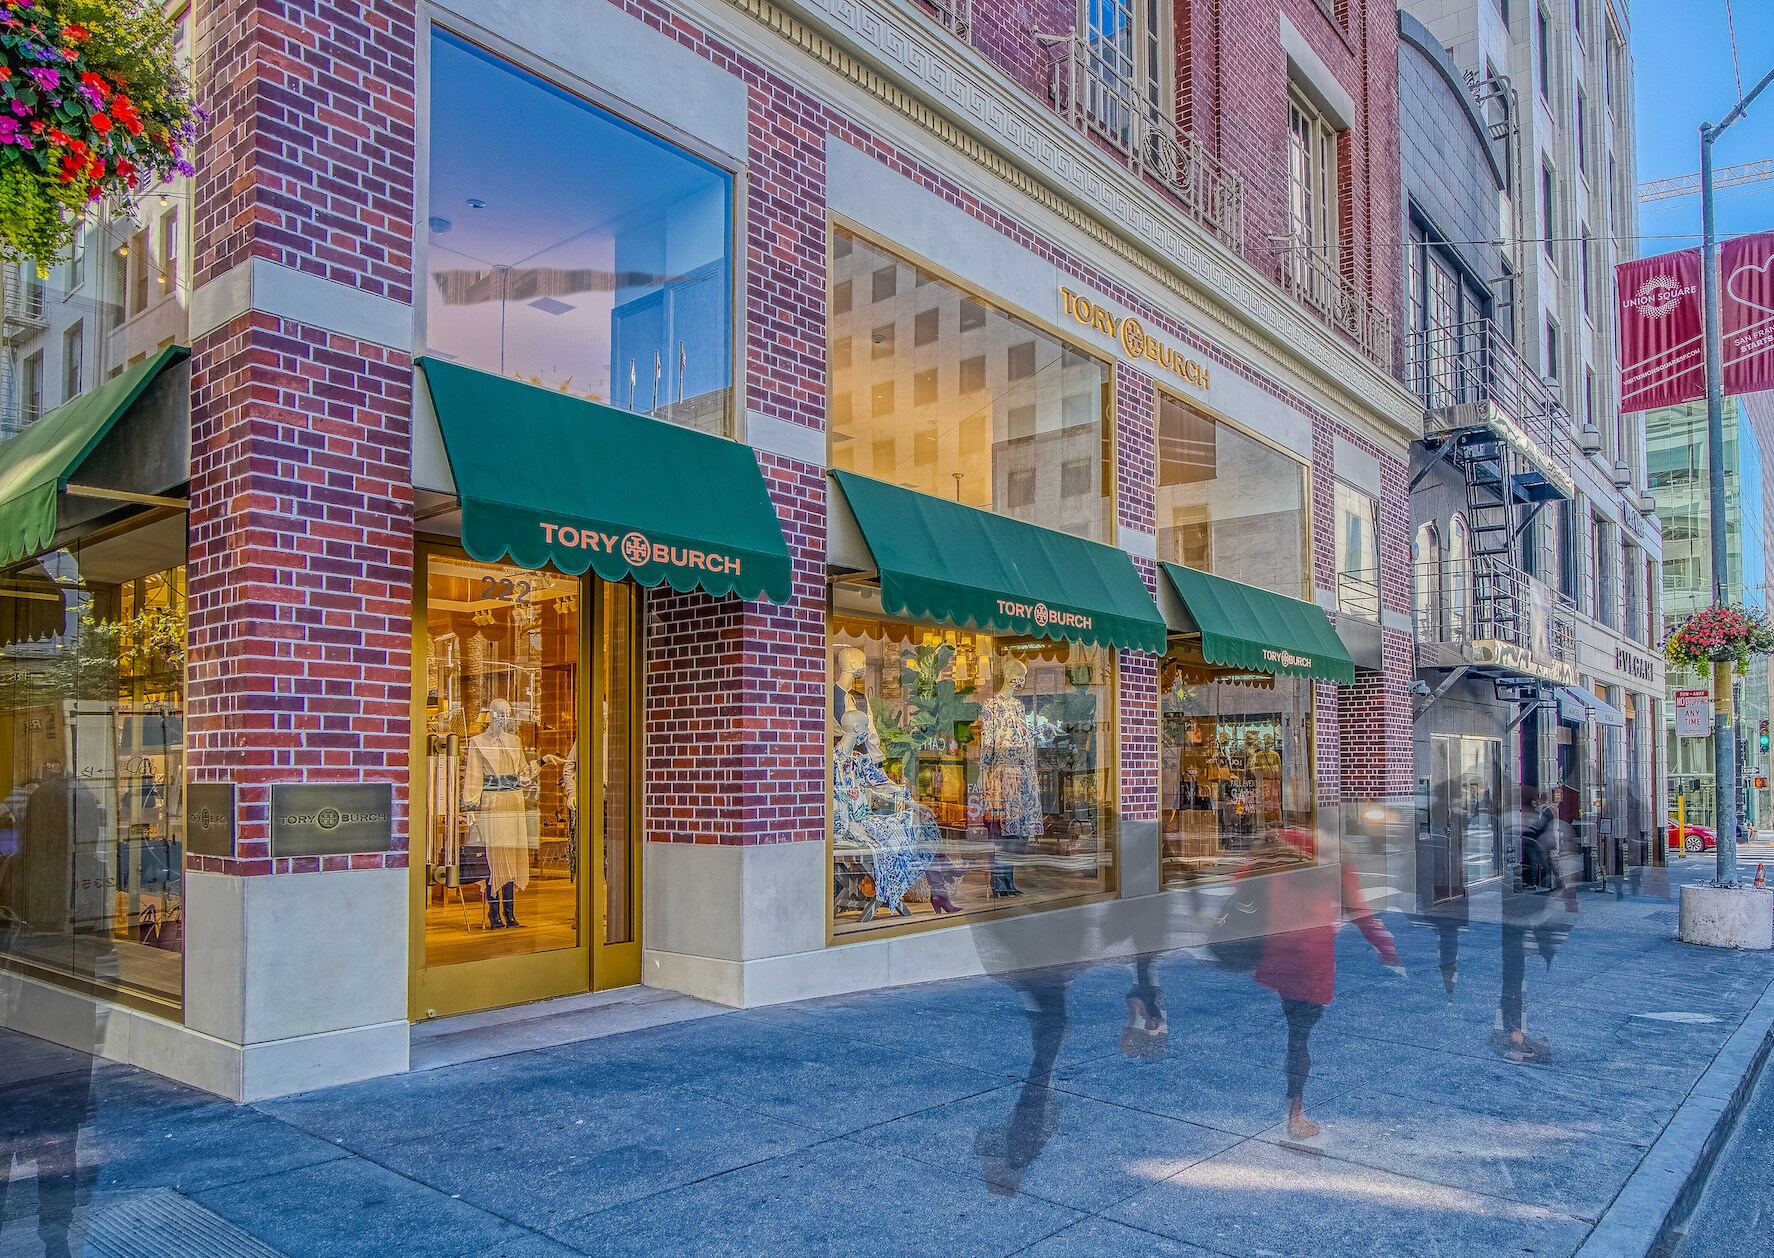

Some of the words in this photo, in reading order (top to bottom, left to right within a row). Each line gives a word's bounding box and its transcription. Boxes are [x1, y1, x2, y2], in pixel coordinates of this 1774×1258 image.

[1622, 294, 1655, 308] UNION
[1657, 286, 1697, 302] SQUARE
[1059, 286, 1122, 339] TORY
[1144, 334, 1211, 391] BURCH
[1734, 335, 1752, 347] SAN
[1740, 335, 1774, 353] STARTS
[540, 522, 619, 554] TORY
[653, 543, 741, 576] BURCH
[481, 575, 531, 604] 222
[996, 599, 1034, 619] TORY
[1049, 610, 1092, 630] BURCH
[1262, 649, 1281, 663] TORY
[1288, 655, 1312, 668] BURCH
[1616, 647, 1654, 682] BVLGARI
[1684, 718, 1701, 726] TIME
[279, 814, 316, 826] TORY
[340, 813, 387, 823] BURCH
